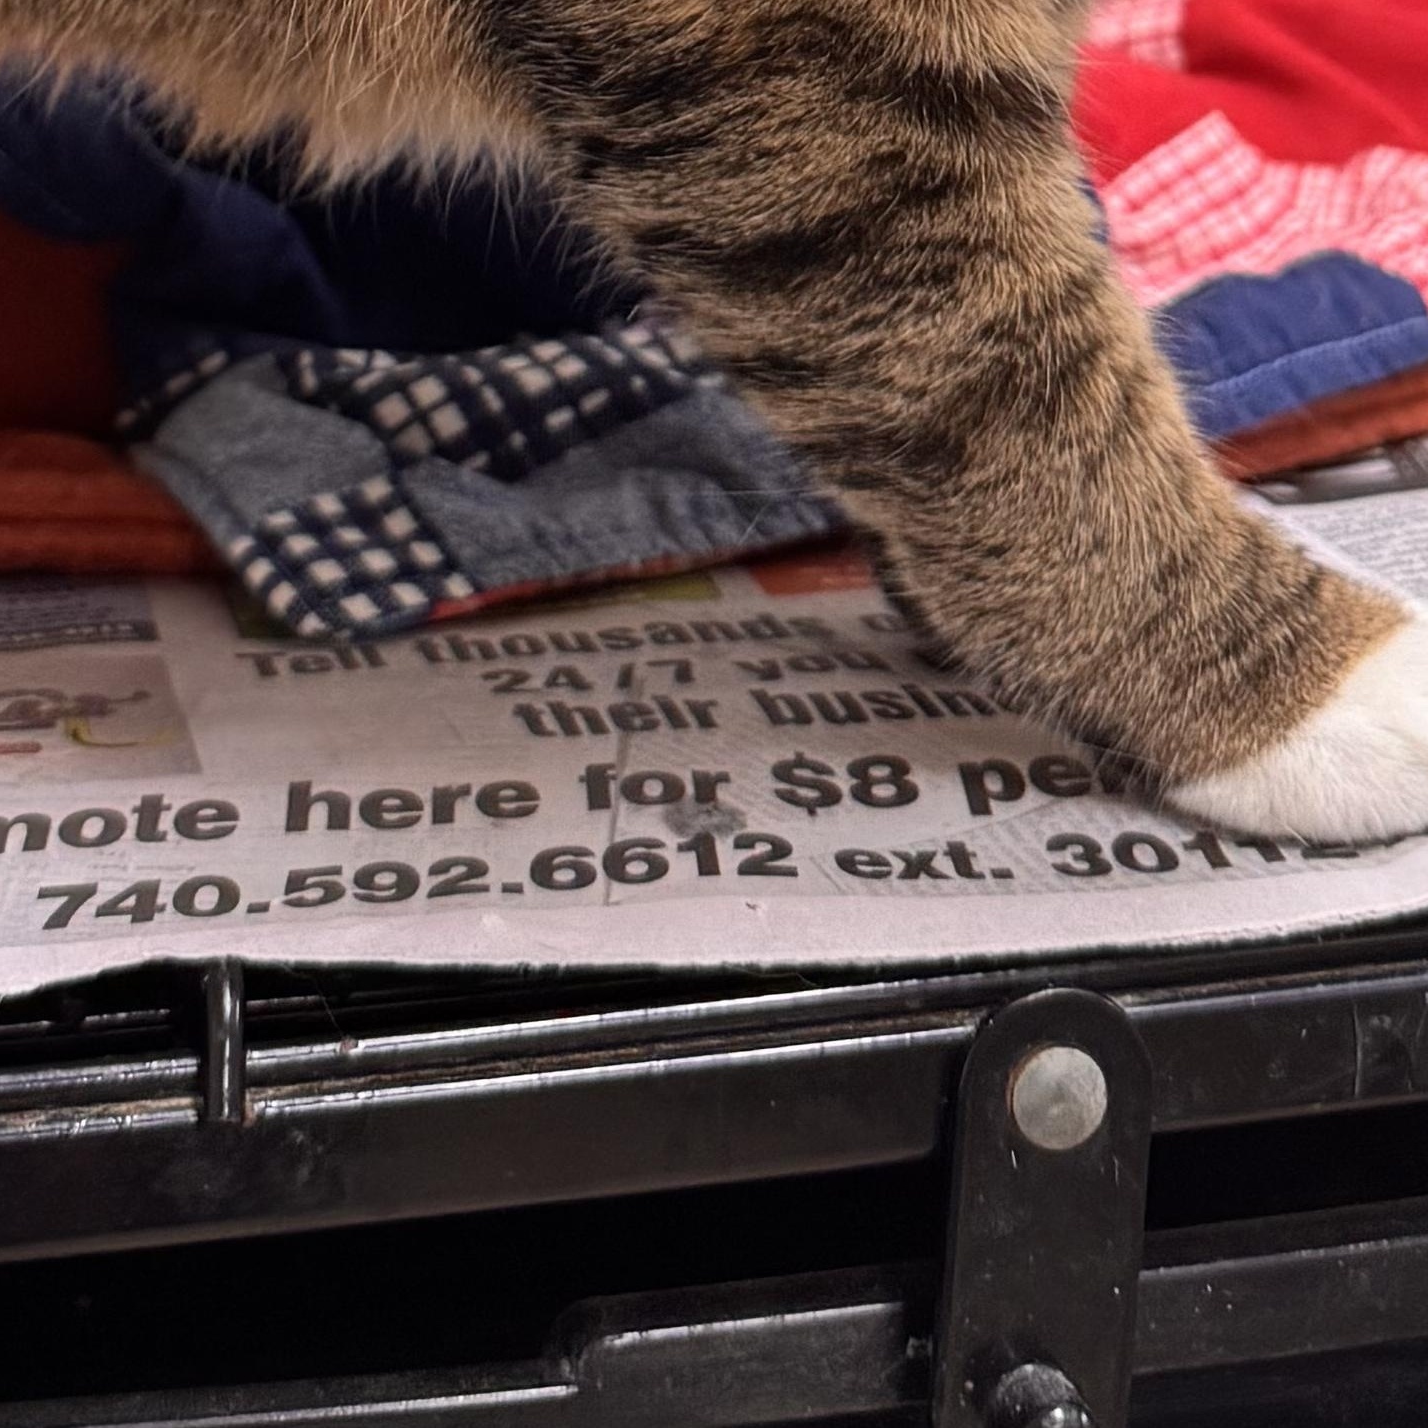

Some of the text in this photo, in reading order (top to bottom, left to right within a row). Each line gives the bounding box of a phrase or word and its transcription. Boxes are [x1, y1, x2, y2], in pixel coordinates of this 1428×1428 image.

[236, 639, 383, 678] Tell
[415, 613, 840, 664] thousands
[481, 658, 697, 695] 24/7
[513, 682, 996, 739] their busin
[286, 781, 540, 834] here
[579, 761, 731, 813] for
[773, 752, 920, 818] $8
[37, 832, 799, 931] 740.592.6612
[834, 838, 1014, 883] ext.
